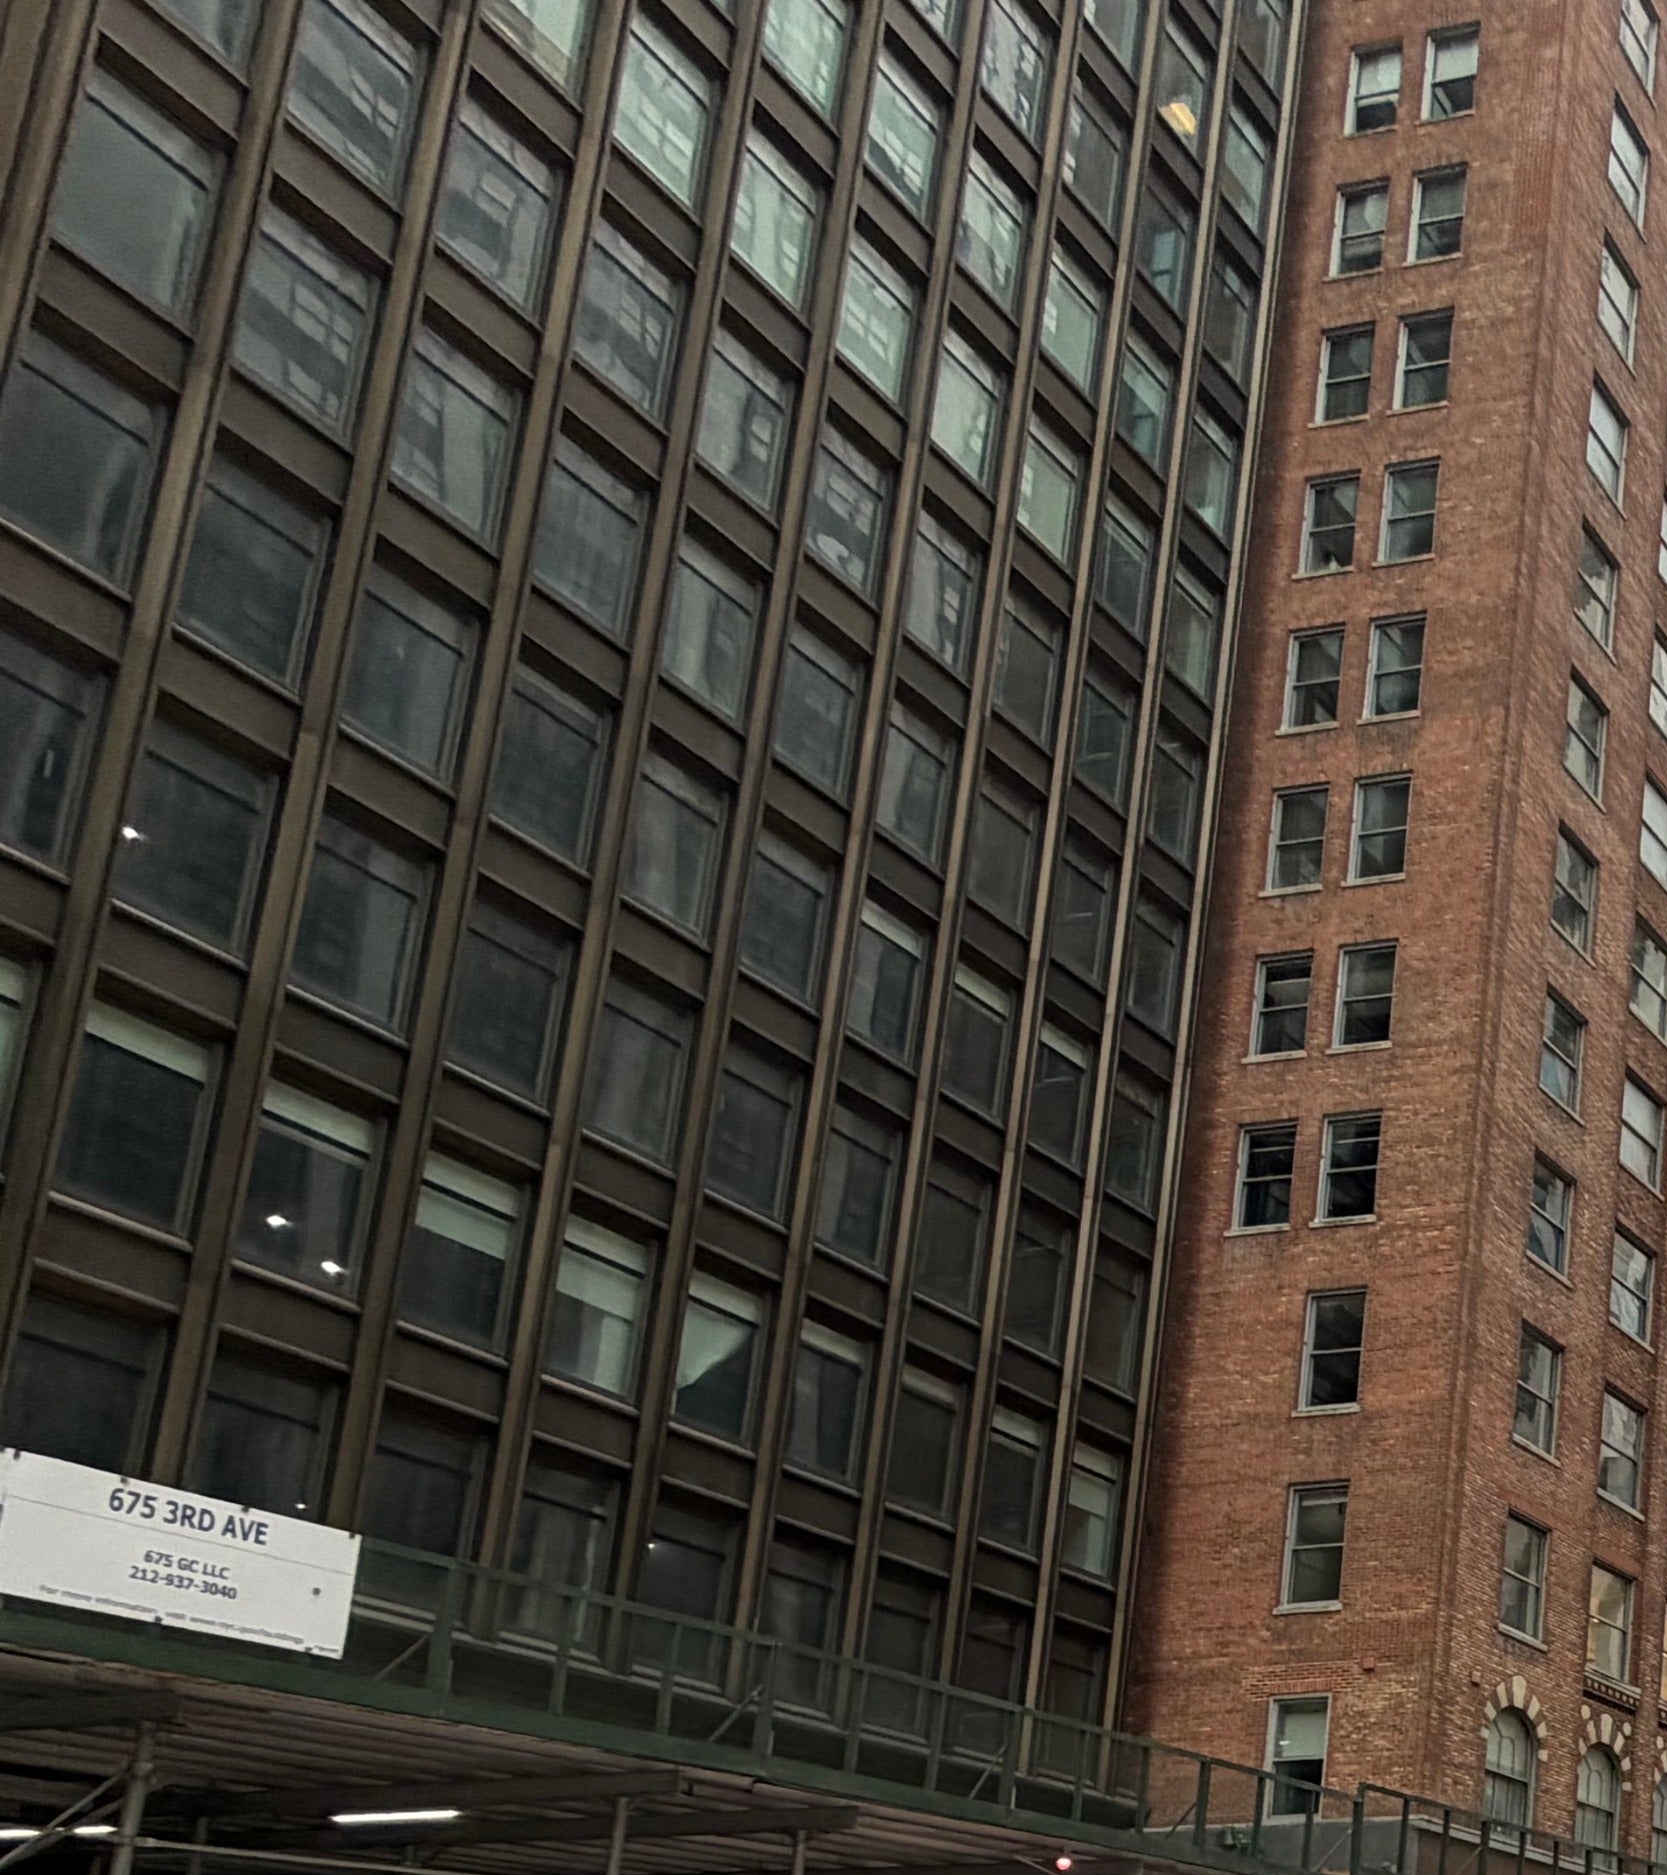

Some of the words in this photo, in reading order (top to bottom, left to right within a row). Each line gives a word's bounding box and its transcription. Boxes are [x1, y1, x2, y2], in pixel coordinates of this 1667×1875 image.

[108, 1487, 157, 1520] 675
[163, 1500, 215, 1533] 3RD
[221, 1515, 270, 1546] AVE
[129, 1565, 238, 1600] 212-937-3040
[143, 1550, 173, 1568] 675
[177, 1558, 200, 1574] GC
[202, 1563, 231, 1580] LLC
